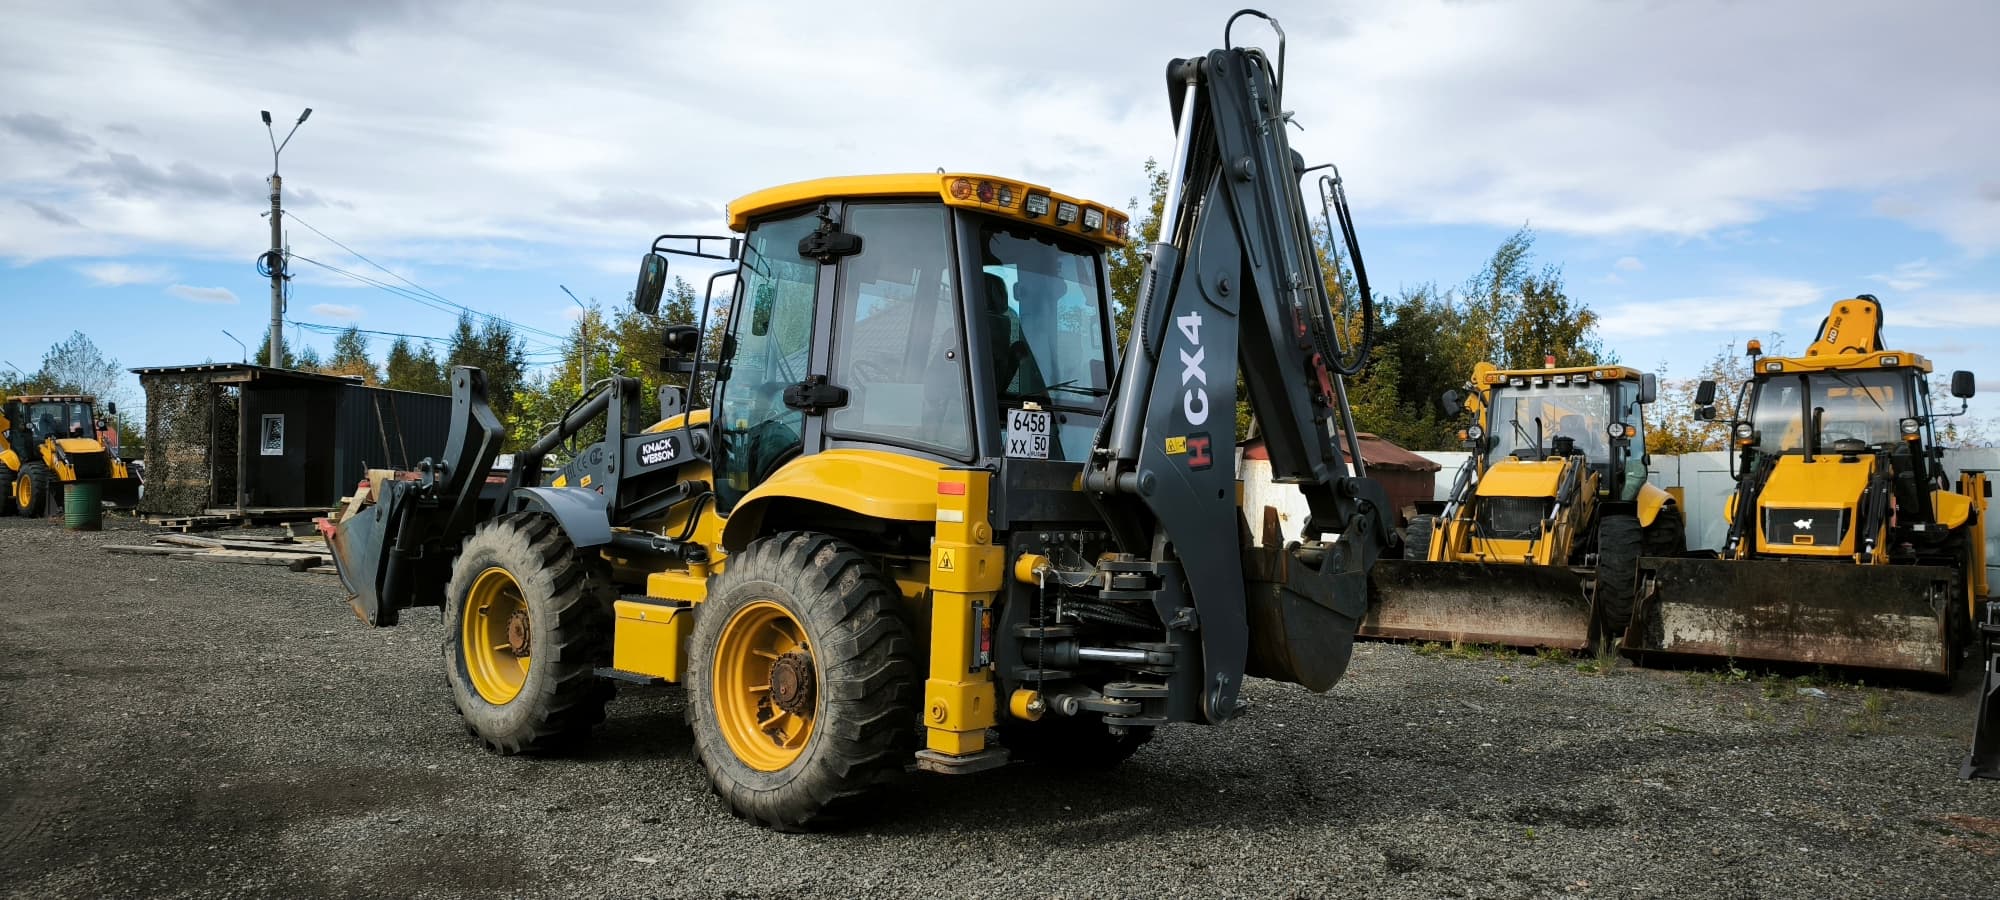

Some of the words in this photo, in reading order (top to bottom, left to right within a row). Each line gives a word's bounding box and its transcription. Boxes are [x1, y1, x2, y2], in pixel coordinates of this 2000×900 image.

[1014, 412, 1045, 432] 6458
[642, 438, 671, 455] KNACK
[1034, 436, 1047, 451] 50
[642, 448, 674, 464] WESSON
